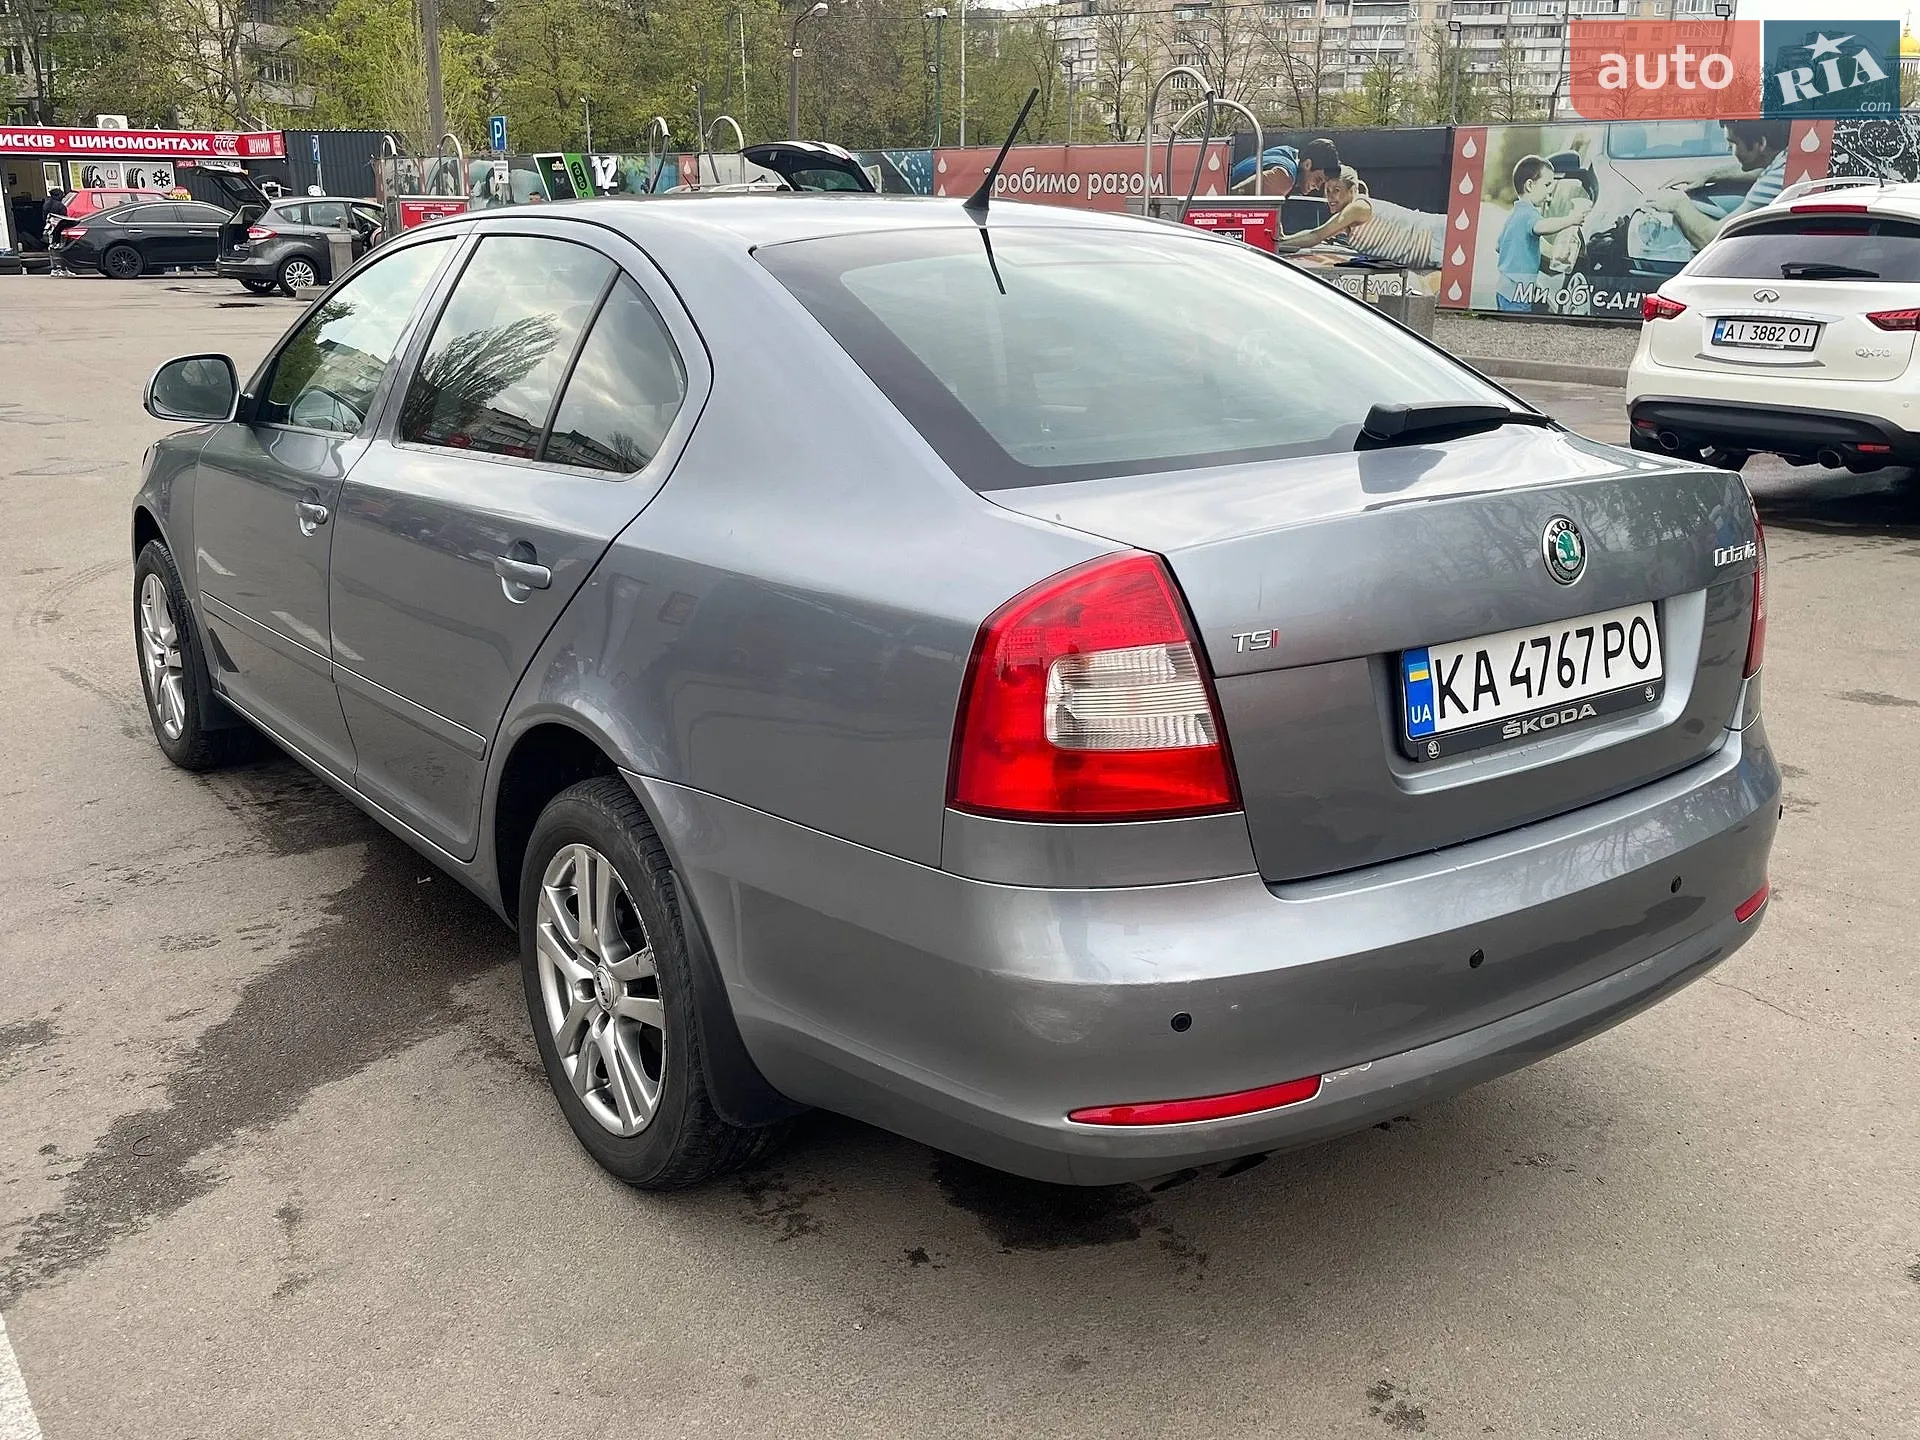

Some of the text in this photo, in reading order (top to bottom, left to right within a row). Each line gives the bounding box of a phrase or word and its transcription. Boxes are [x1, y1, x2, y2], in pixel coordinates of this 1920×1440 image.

[69, 135, 210, 151] ШИНОМОНТАЖ
[494, 121, 502, 147] P
[983, 166, 1164, 199] робимо разом
[1513, 282, 1646, 310] Ми об'єдн
[1724, 324, 1809, 344] AI 3882 OI
[1714, 540, 1757, 567] Octavia
[1232, 629, 1279, 653] TSI
[1435, 616, 1651, 719] KA 4767 PO
[1411, 703, 1433, 724] UA
[1502, 703, 1597, 741] ŠKODA
